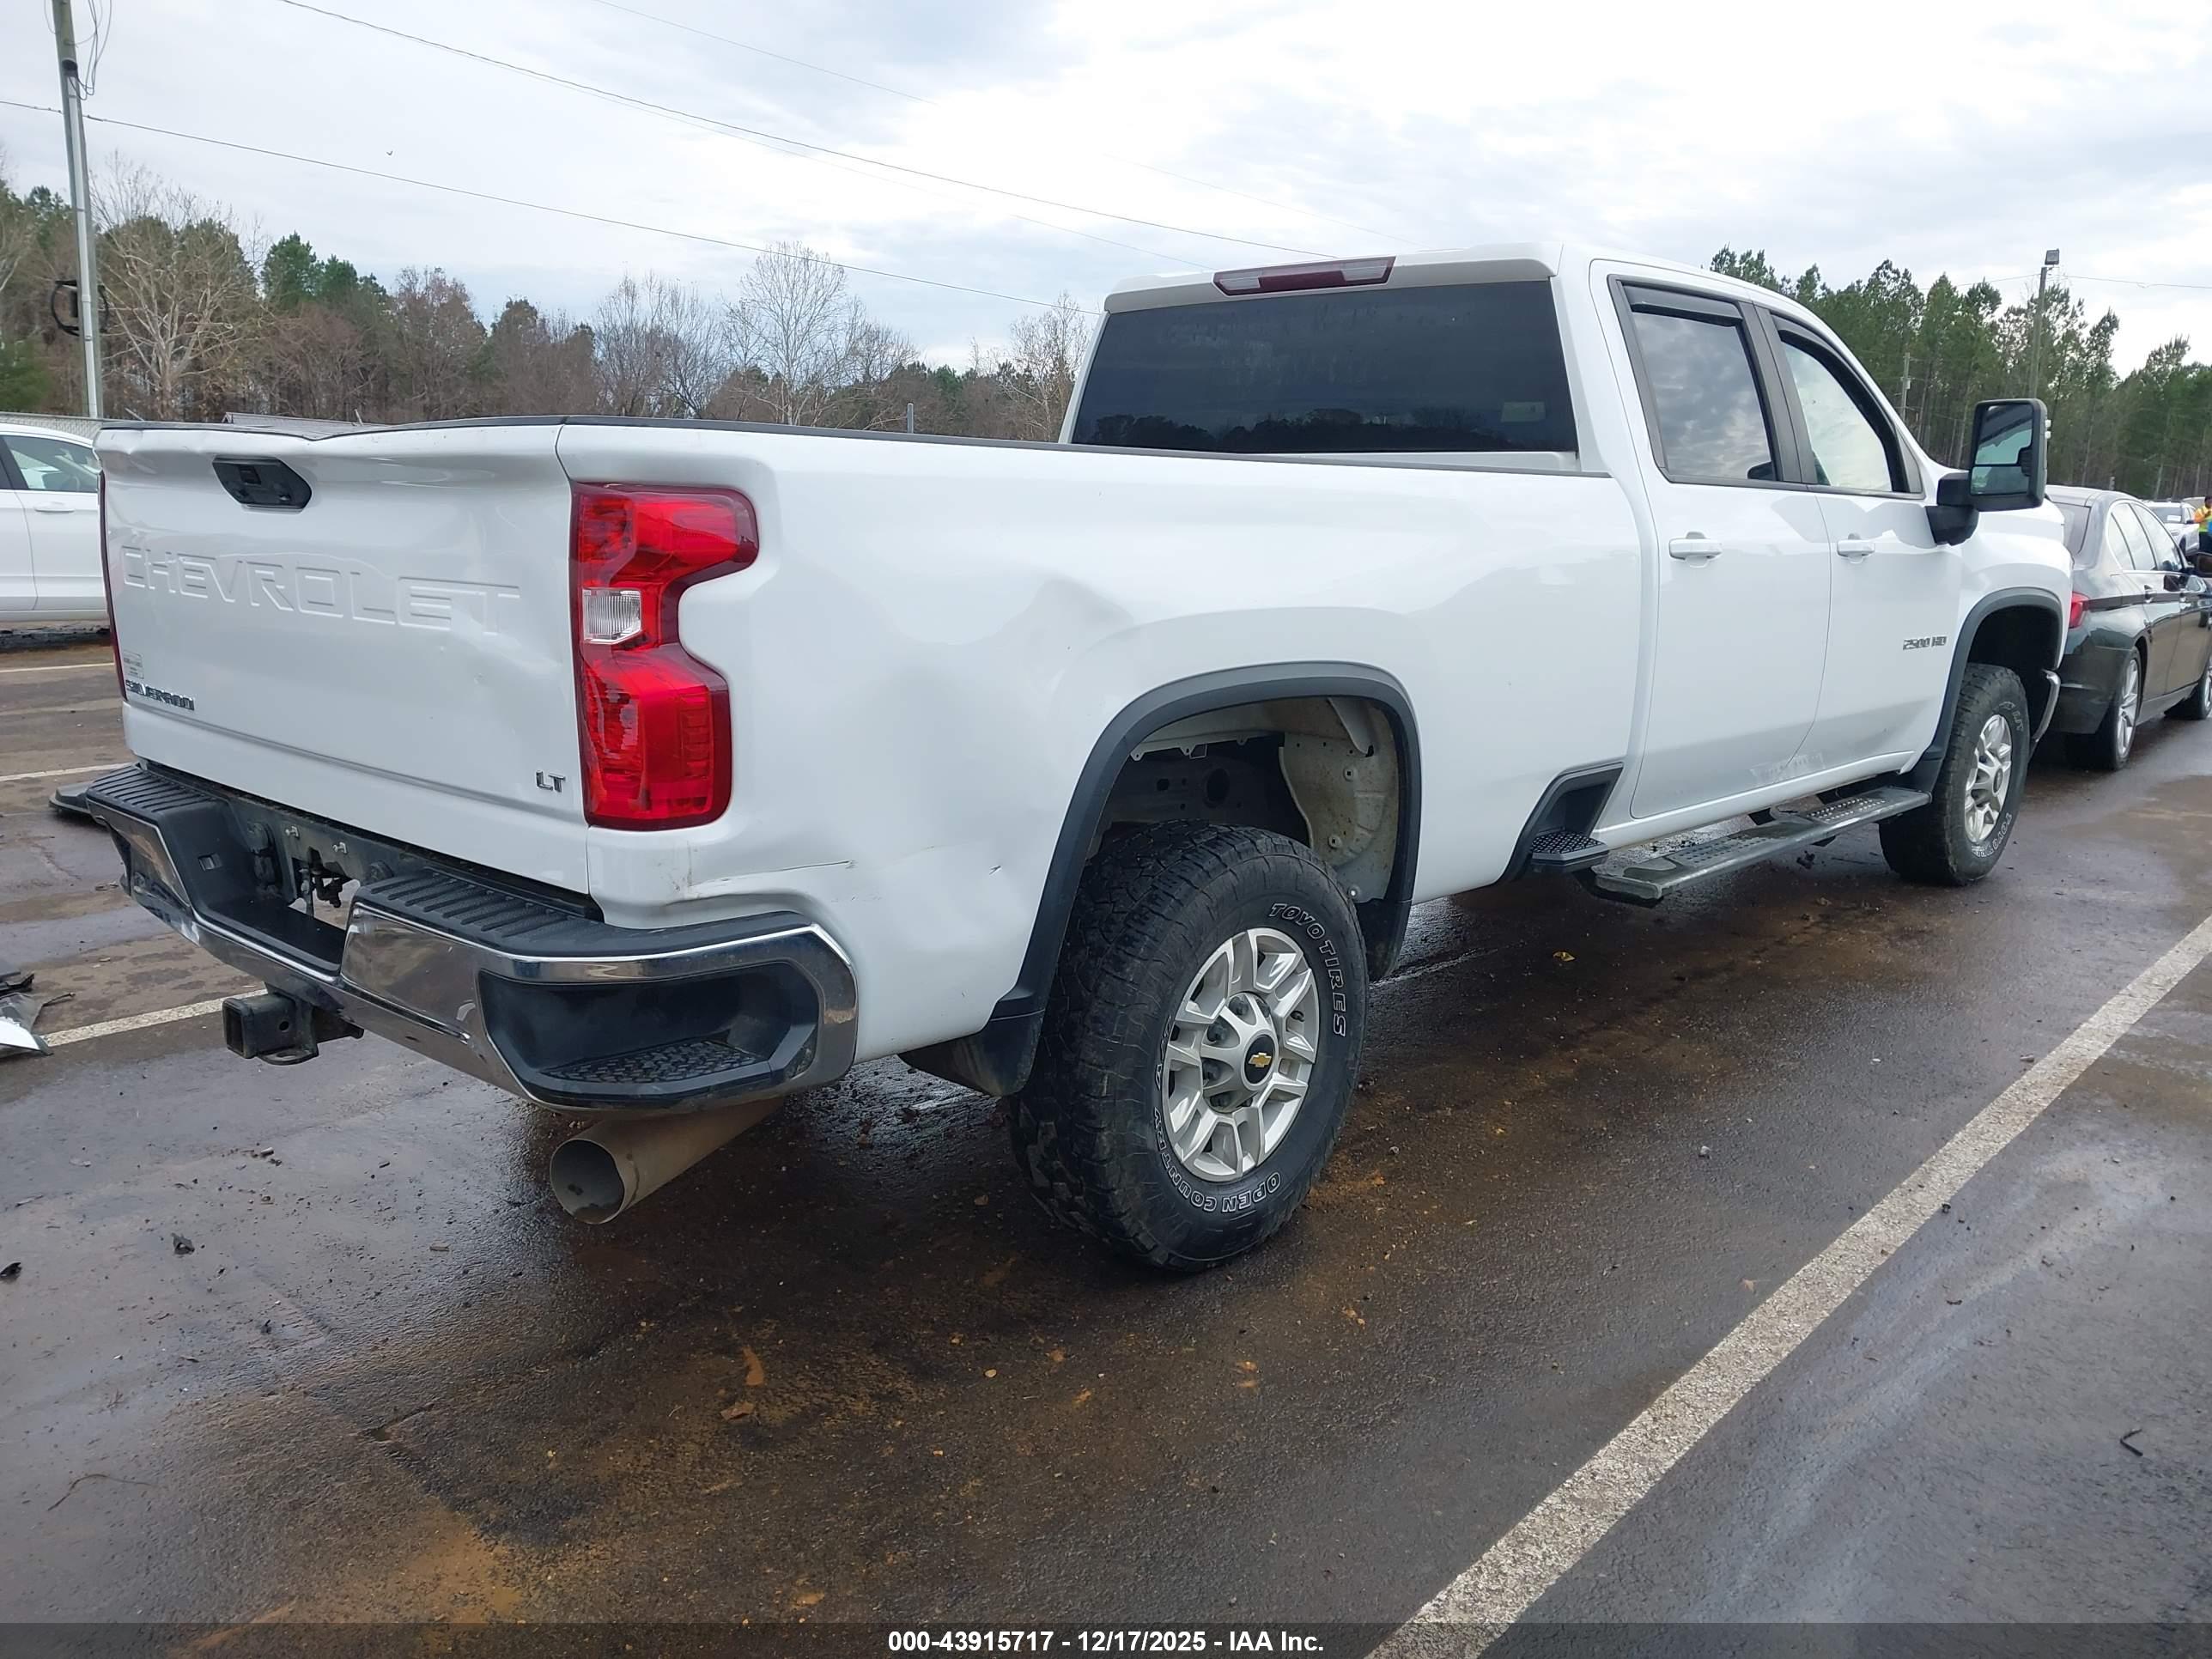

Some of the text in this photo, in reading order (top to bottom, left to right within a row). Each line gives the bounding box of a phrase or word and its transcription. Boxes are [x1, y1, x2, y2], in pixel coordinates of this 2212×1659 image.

[121, 544, 521, 636] CHEVROLET
[1902, 636, 1948, 650] 2500 HD
[535, 770, 566, 793] LT
[1268, 902, 1347, 1037] TOYO TIRES
[1154, 1106, 1218, 1212] COUNTRY
[1221, 1171, 1281, 1212] OPEN
